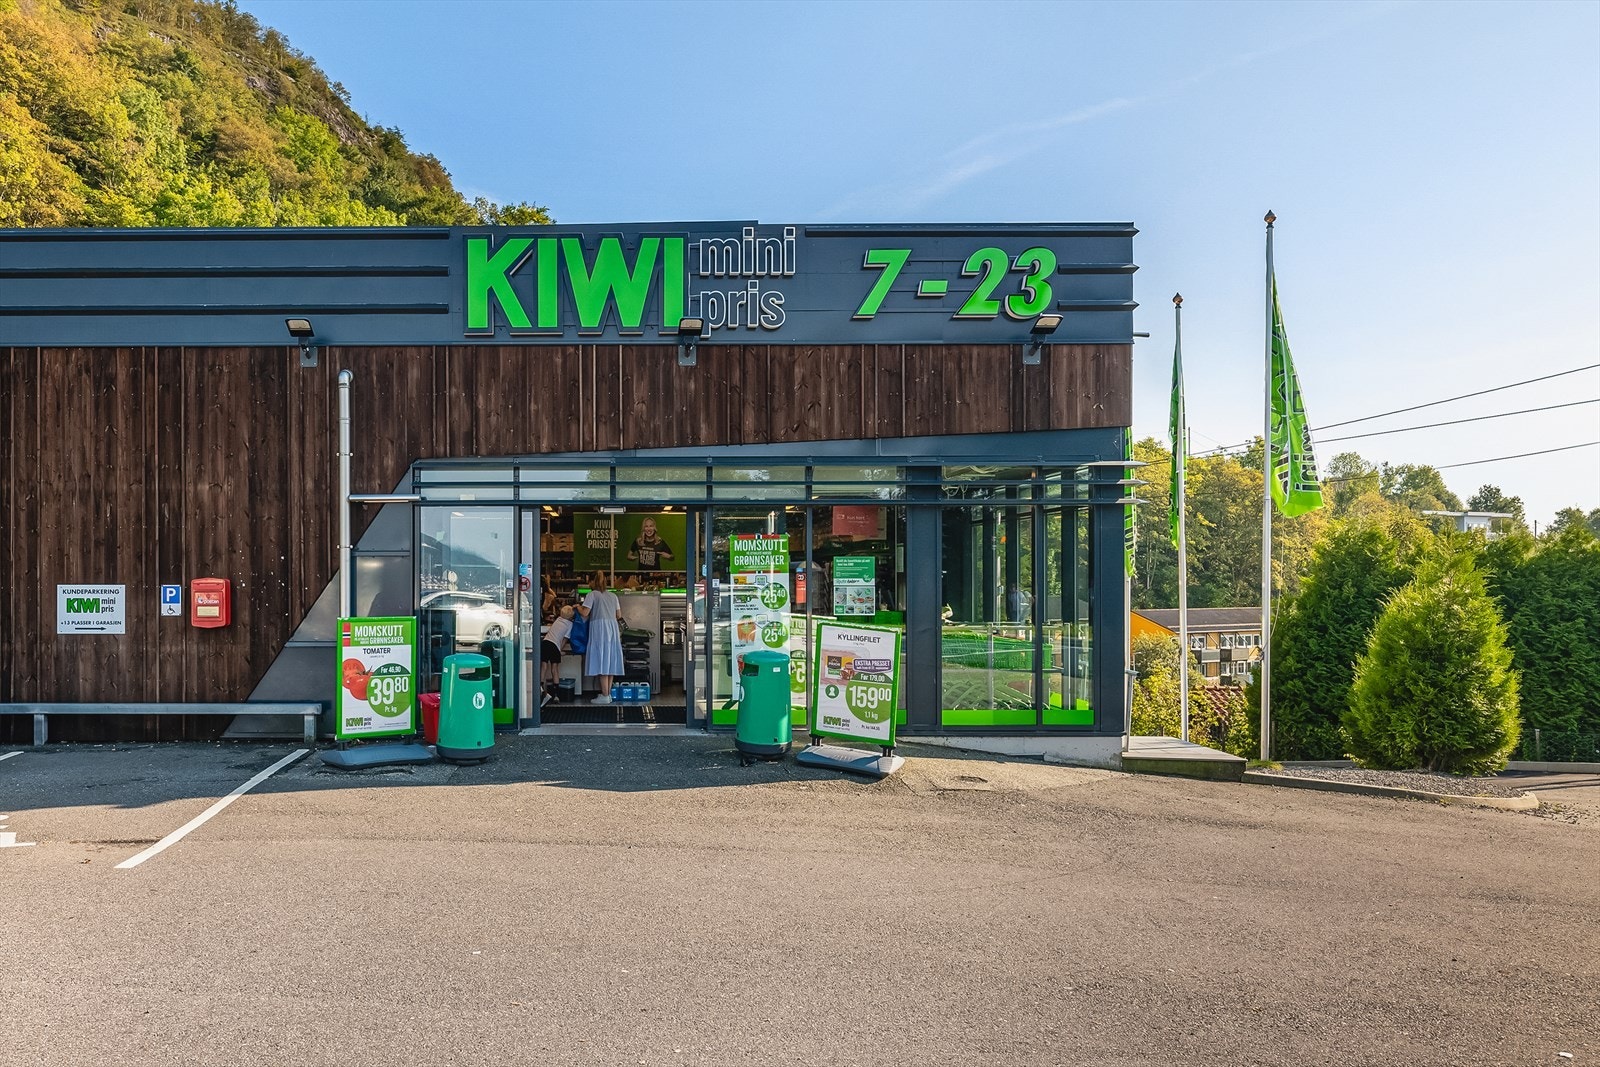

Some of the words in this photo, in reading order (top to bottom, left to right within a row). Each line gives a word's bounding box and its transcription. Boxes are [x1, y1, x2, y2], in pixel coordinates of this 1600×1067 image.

[700, 227, 796, 275] mini
[465, 236, 687, 331] KIWI
[854, 249, 912, 318] 7
[953, 246, 1057, 319] 23
[700, 280, 786, 338] pris
[594, 520, 611, 528] KIWI
[101, 597, 116, 605] mini
[166, 588, 177, 602] P
[66, 597, 101, 614] KIWI
[101, 605, 115, 614] pris
[354, 625, 403, 637] MOMSKUTT
[837, 633, 881, 644] KYLLINGFILET
